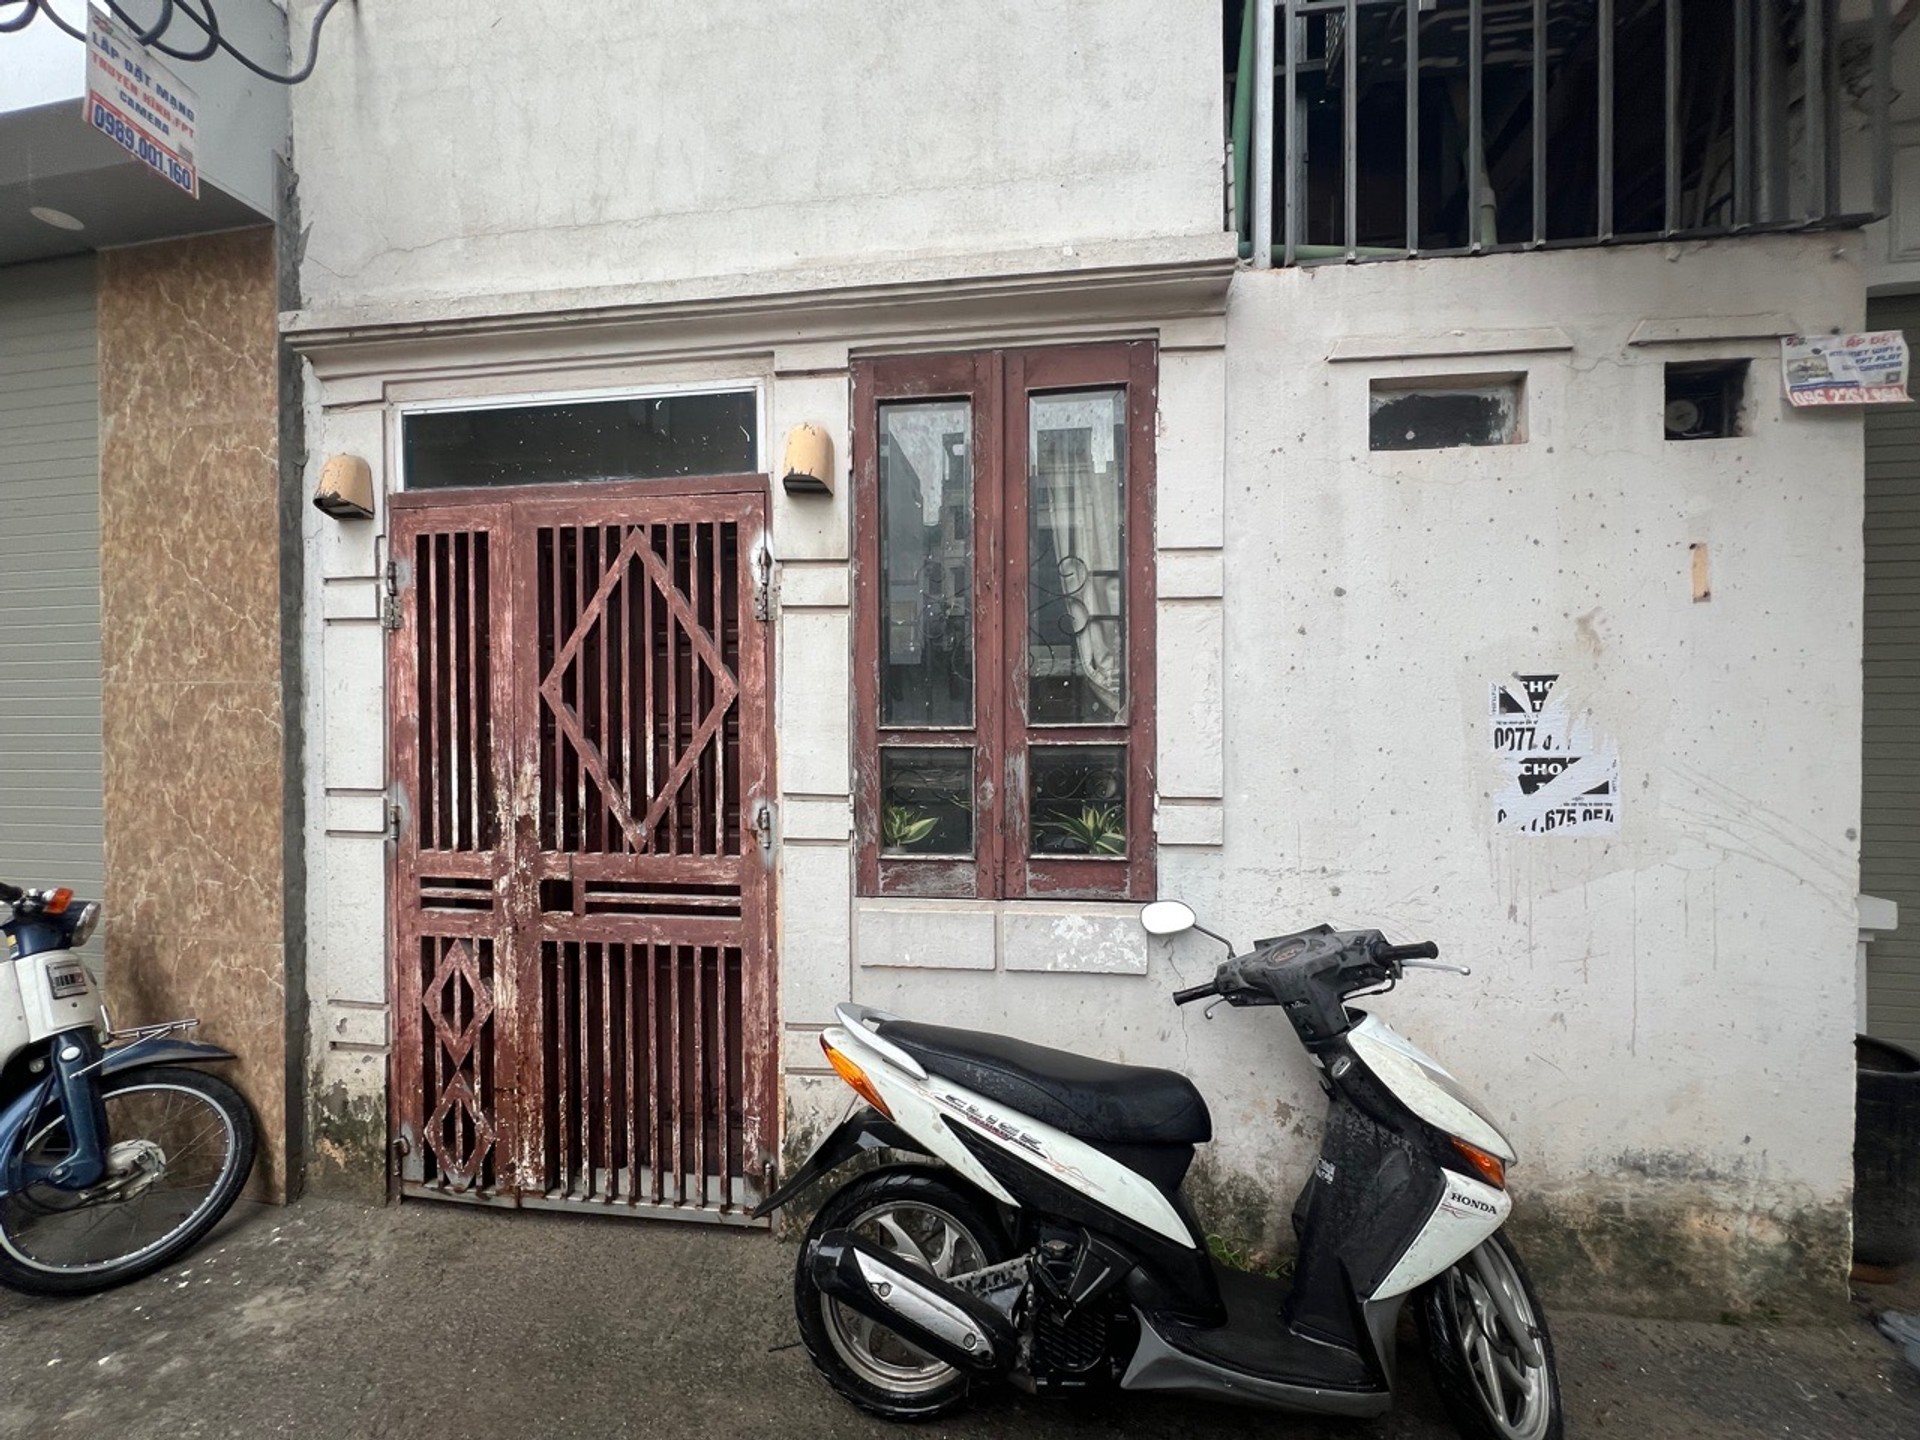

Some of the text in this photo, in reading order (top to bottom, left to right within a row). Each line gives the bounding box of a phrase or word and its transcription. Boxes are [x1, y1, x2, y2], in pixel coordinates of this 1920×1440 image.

[119, 90, 169, 136] CAMERA
[94, 104, 191, 190] 0989.001.160
[1522, 763, 1563, 776] CHO
[1450, 1192, 1497, 1215] HONDA
